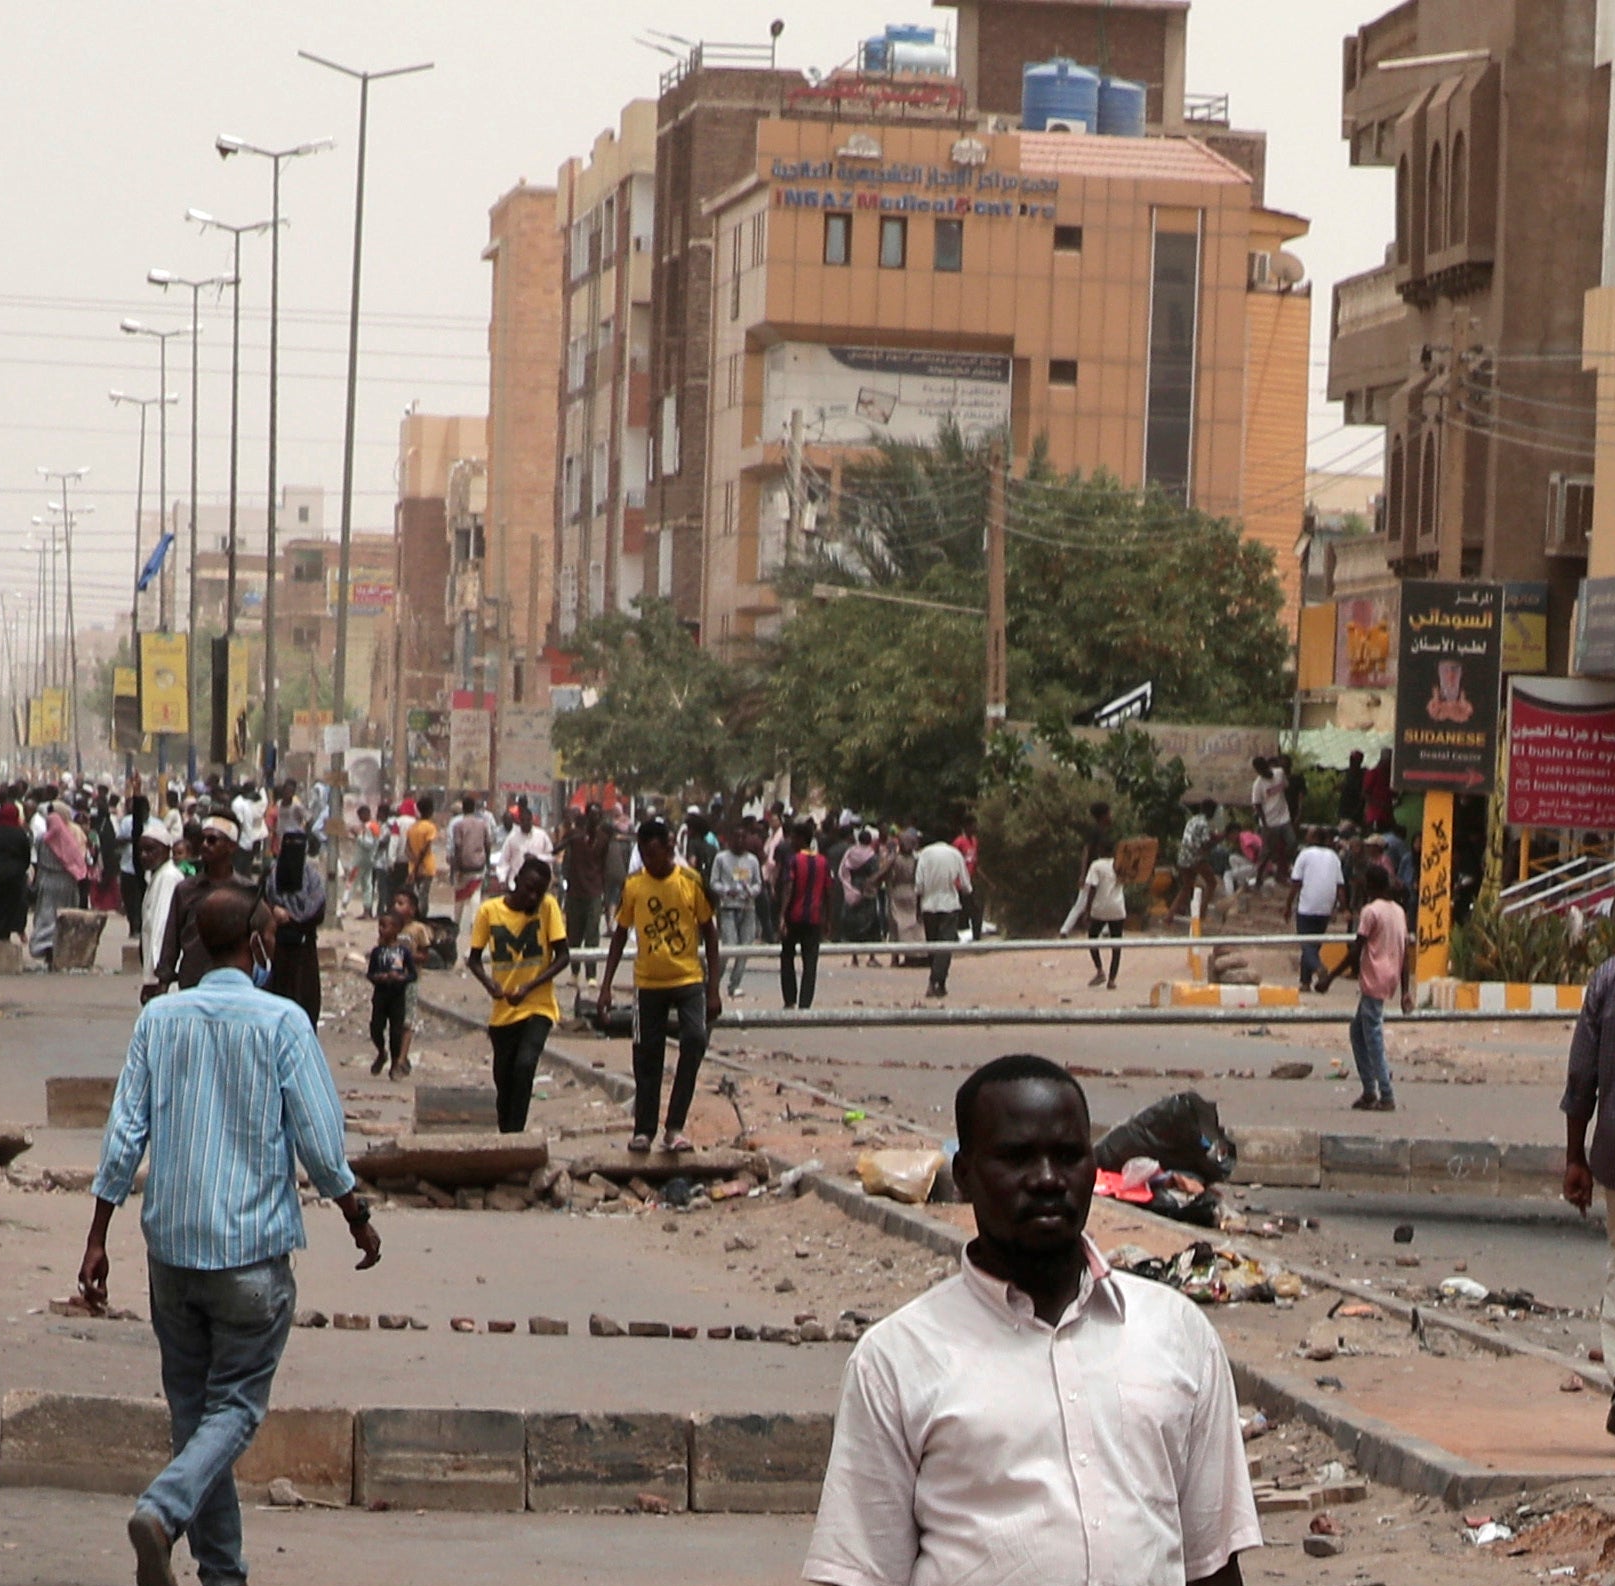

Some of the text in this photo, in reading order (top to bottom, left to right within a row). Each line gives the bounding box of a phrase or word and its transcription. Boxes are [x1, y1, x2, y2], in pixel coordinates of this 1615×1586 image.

[1455, 592, 1493, 606] المركز
[1409, 608, 1493, 631] السوداني
[1459, 640, 1487, 657] لطب
[1404, 728, 1486, 747] SUDANESE
[1513, 744, 1524, 756] El
[1528, 743, 1573, 758] bushra
[1577, 747, 1594, 761] for
[490, 919, 543, 961] M
